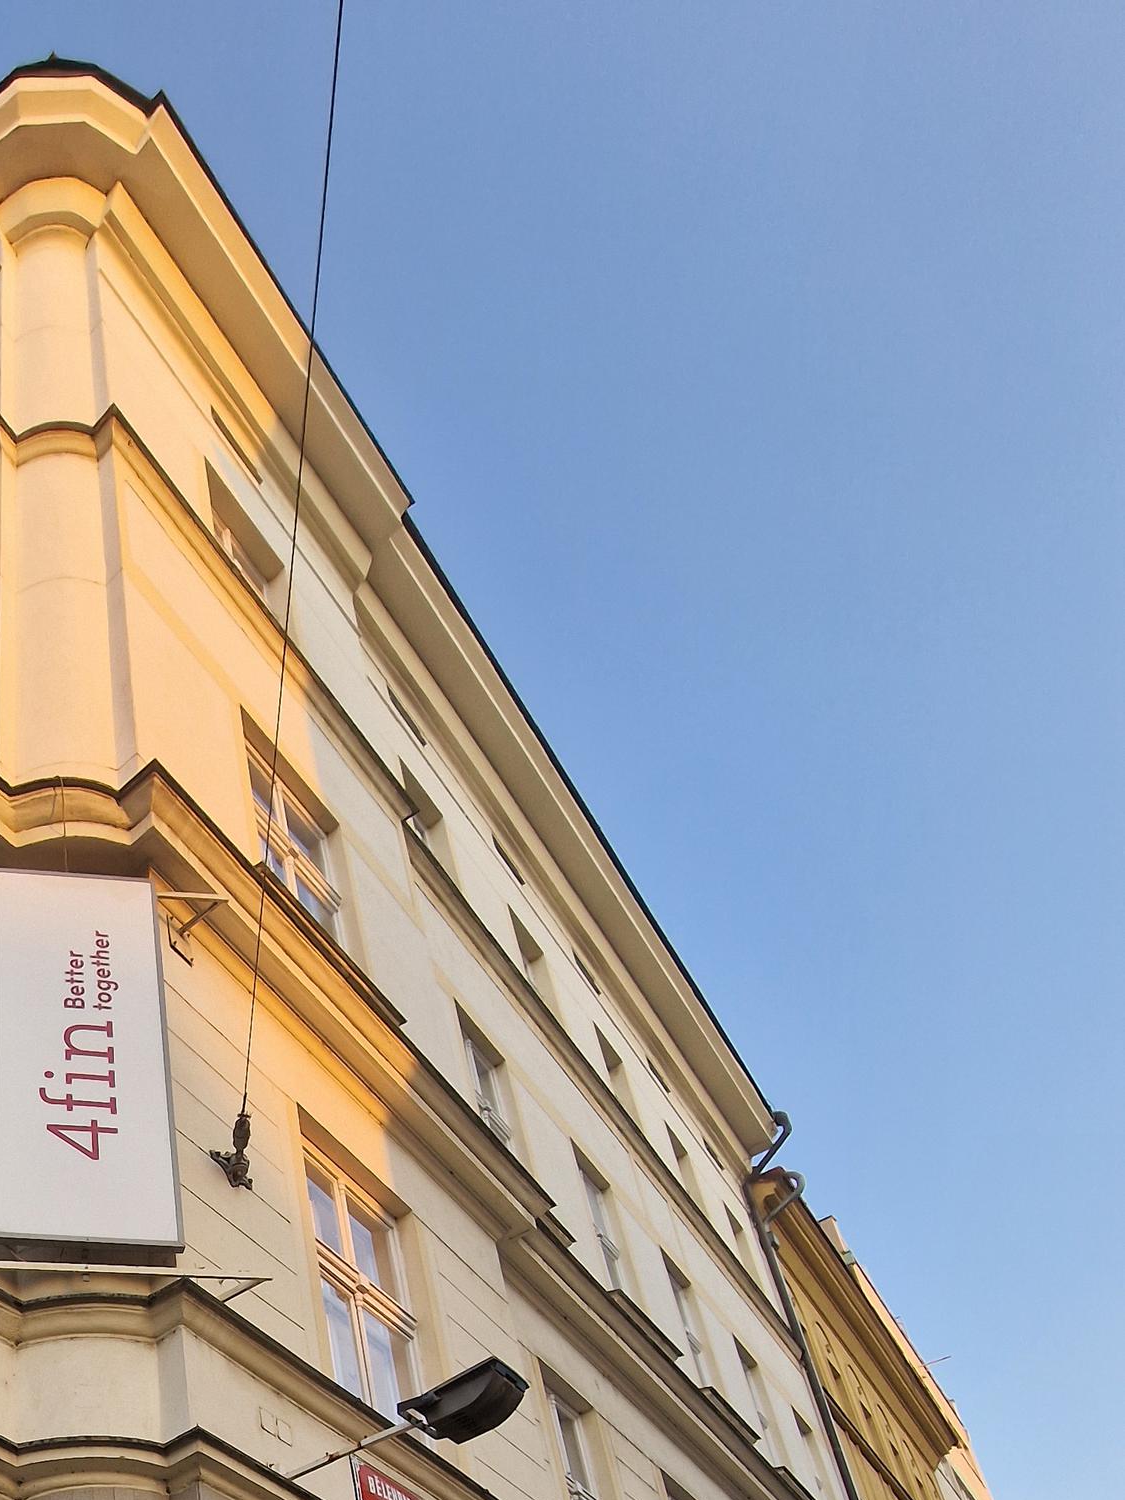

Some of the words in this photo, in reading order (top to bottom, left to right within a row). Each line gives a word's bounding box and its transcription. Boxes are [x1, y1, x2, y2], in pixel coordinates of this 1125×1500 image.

[63, 949, 85, 1010] Better
[89, 930, 119, 1011] together
[38, 1020, 119, 1161] 4fin
